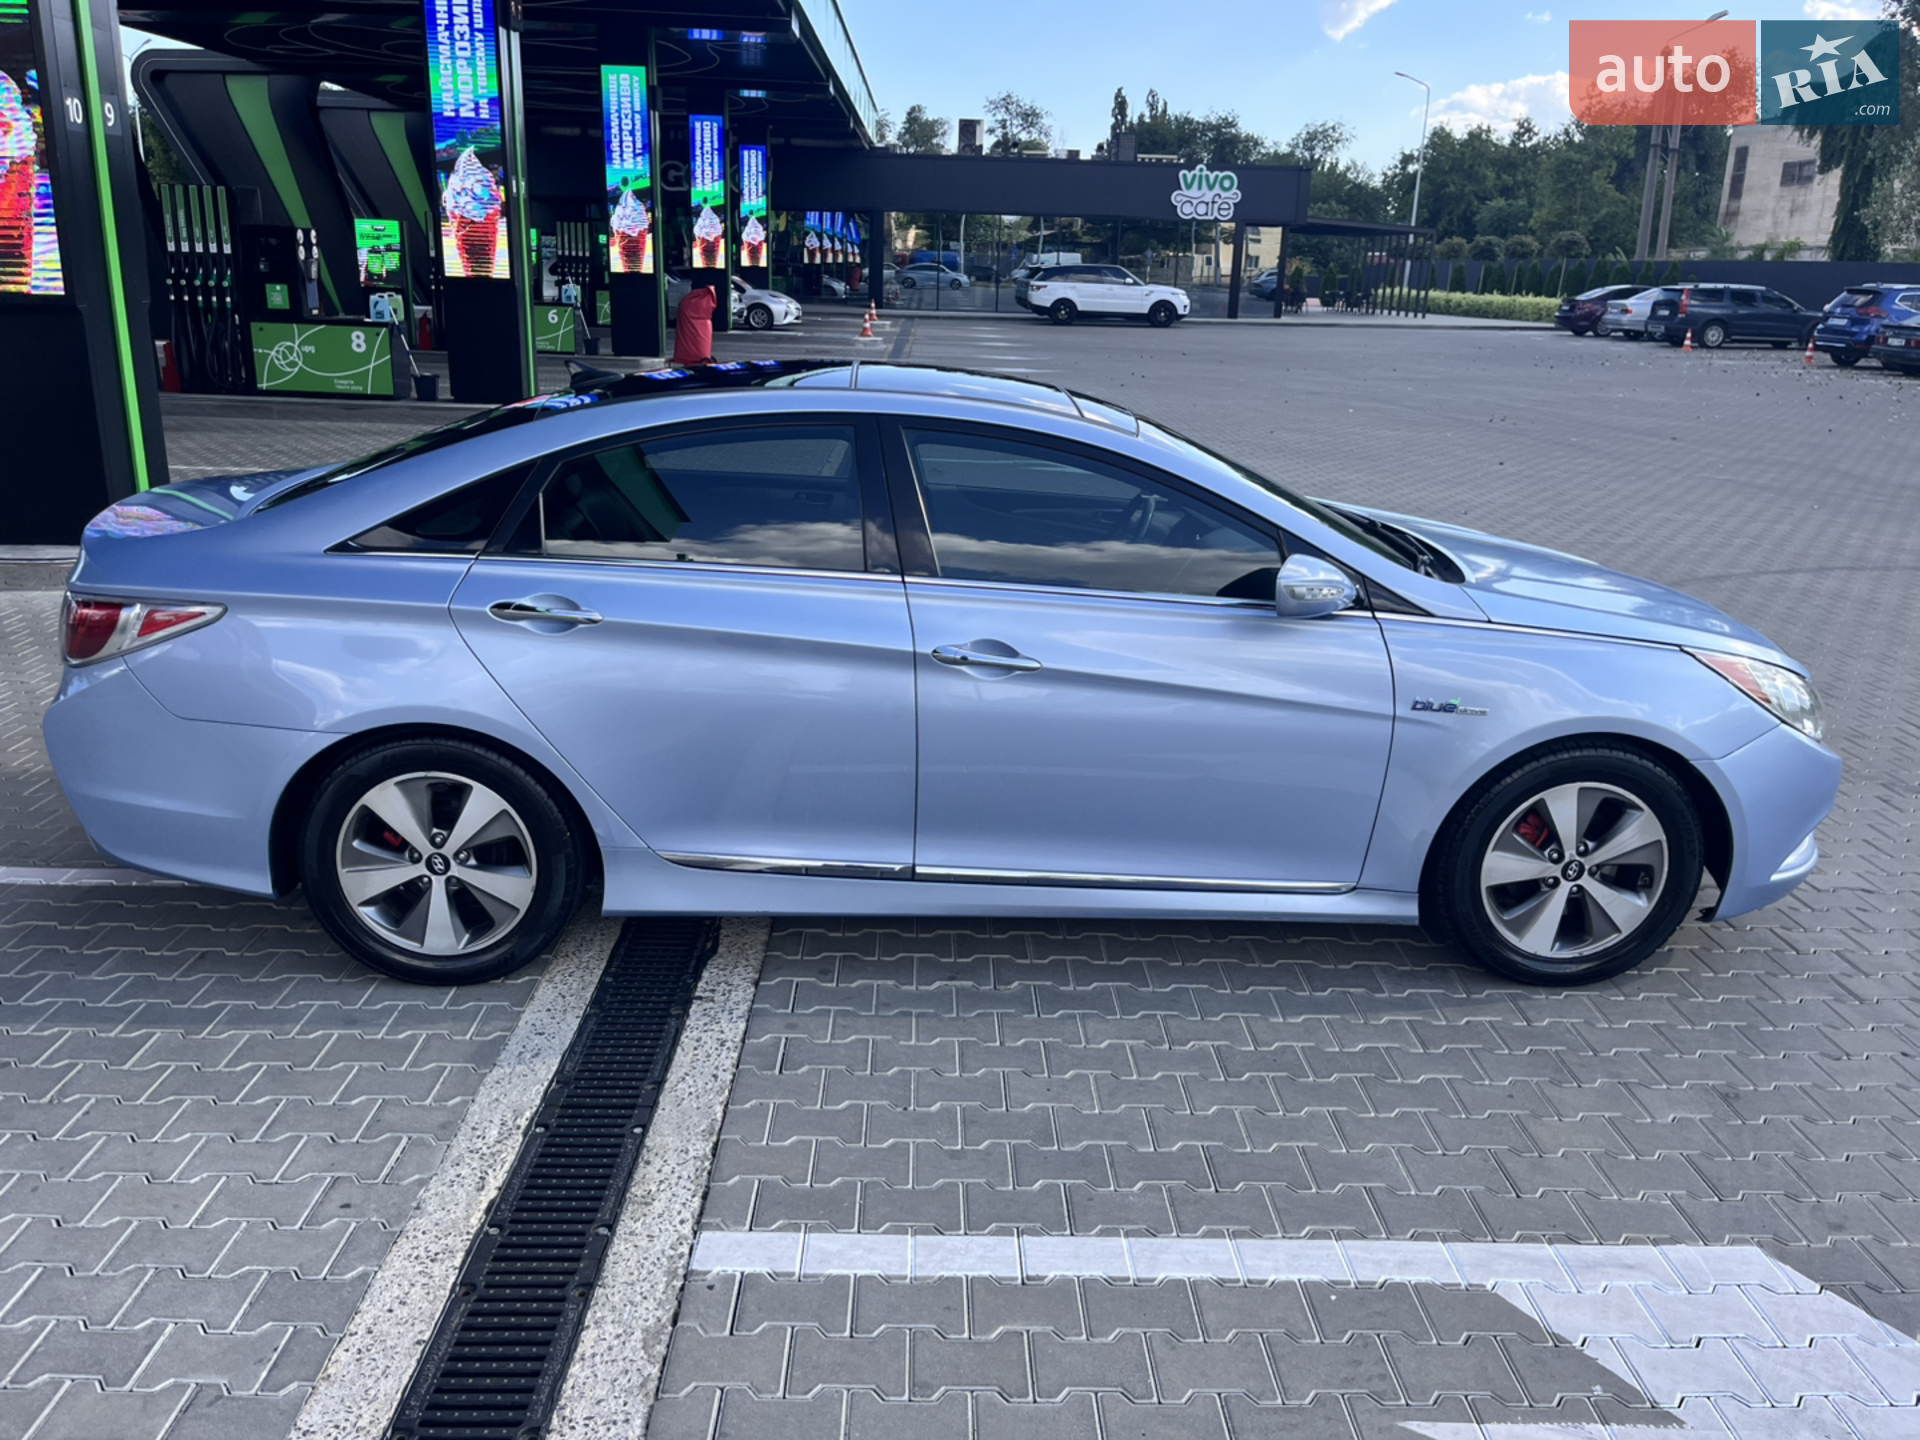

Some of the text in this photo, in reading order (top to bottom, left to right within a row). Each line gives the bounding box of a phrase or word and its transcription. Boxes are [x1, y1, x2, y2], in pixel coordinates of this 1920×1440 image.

[65, 96, 83, 124] 10
[104, 101, 115, 127] 9
[479, 98, 490, 119] НА
[619, 73, 634, 169] МОРОЗИВО
[702, 121, 712, 191] МОРОЗИВО
[1181, 167, 1235, 192] vivo
[1179, 193, 1232, 217] cafe
[547, 309, 558, 323] 6
[351, 330, 366, 352] 8
